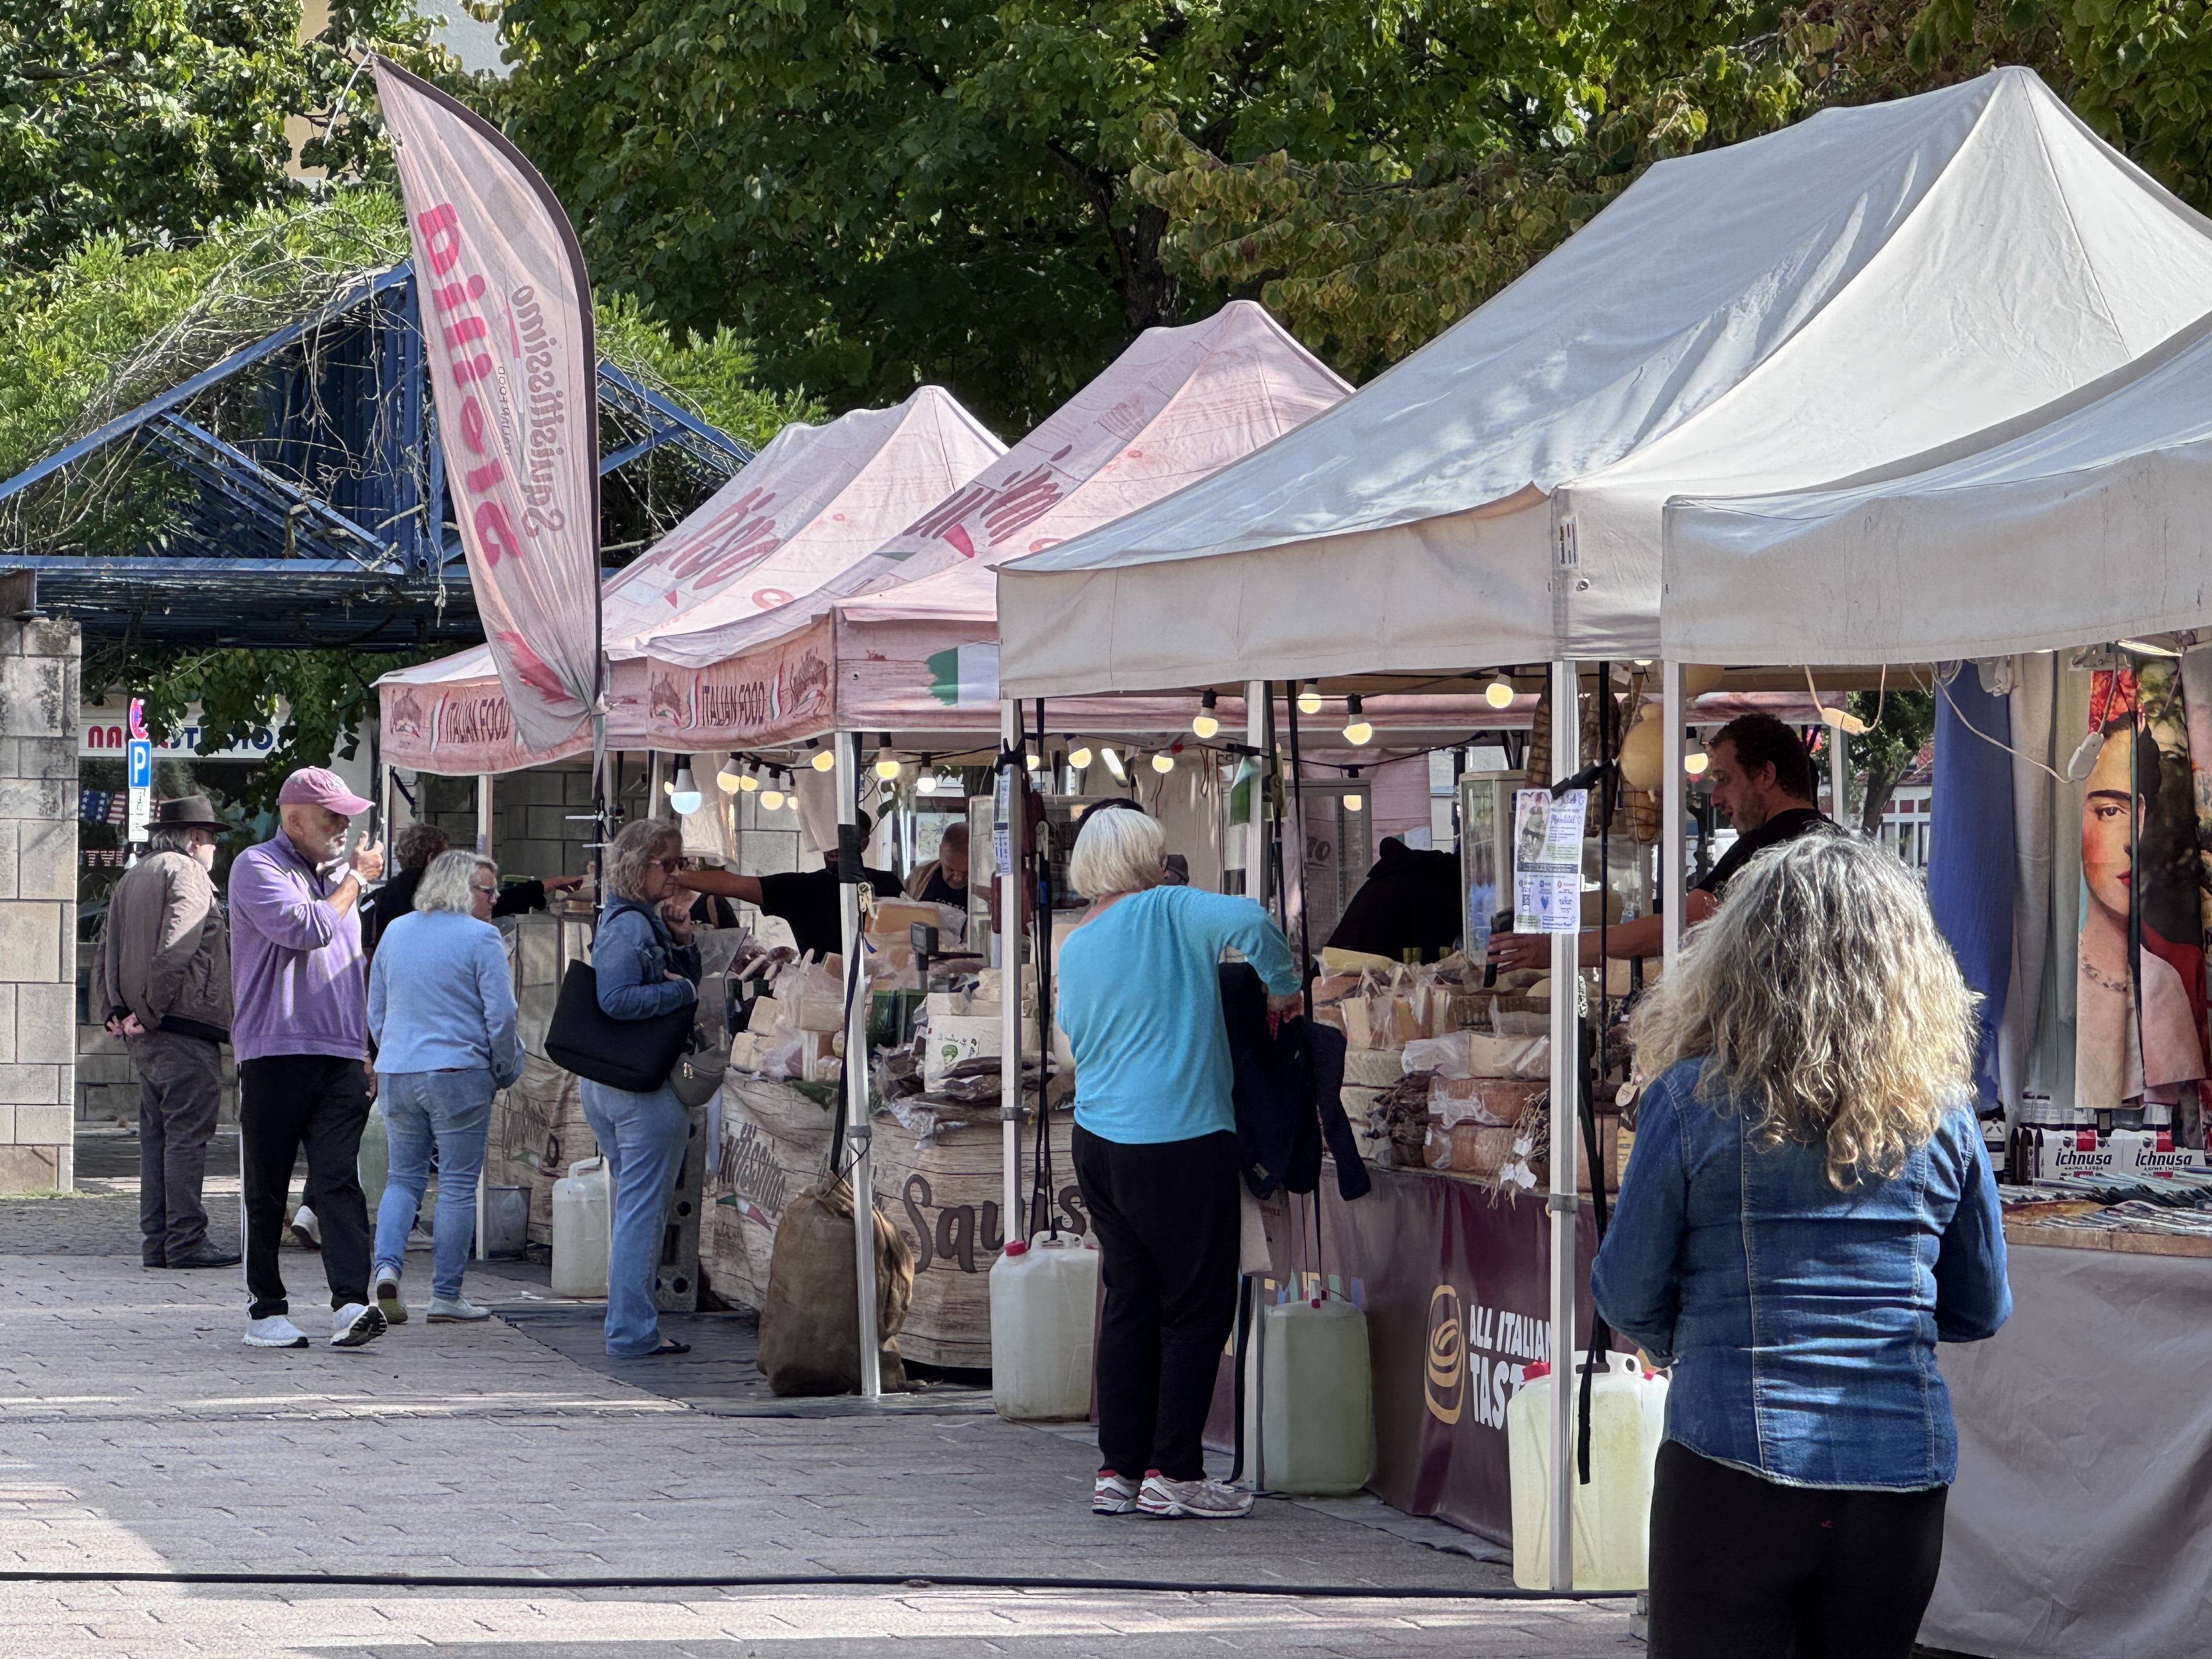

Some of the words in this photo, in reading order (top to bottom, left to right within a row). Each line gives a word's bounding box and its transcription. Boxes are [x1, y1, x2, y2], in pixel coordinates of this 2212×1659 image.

[445, 699, 479, 743] ITALIAN
[702, 686, 736, 726] ITALIAN
[738, 681, 765, 725] FOOD
[134, 747, 145, 783] P
[1470, 1305, 1492, 1350] ALL
